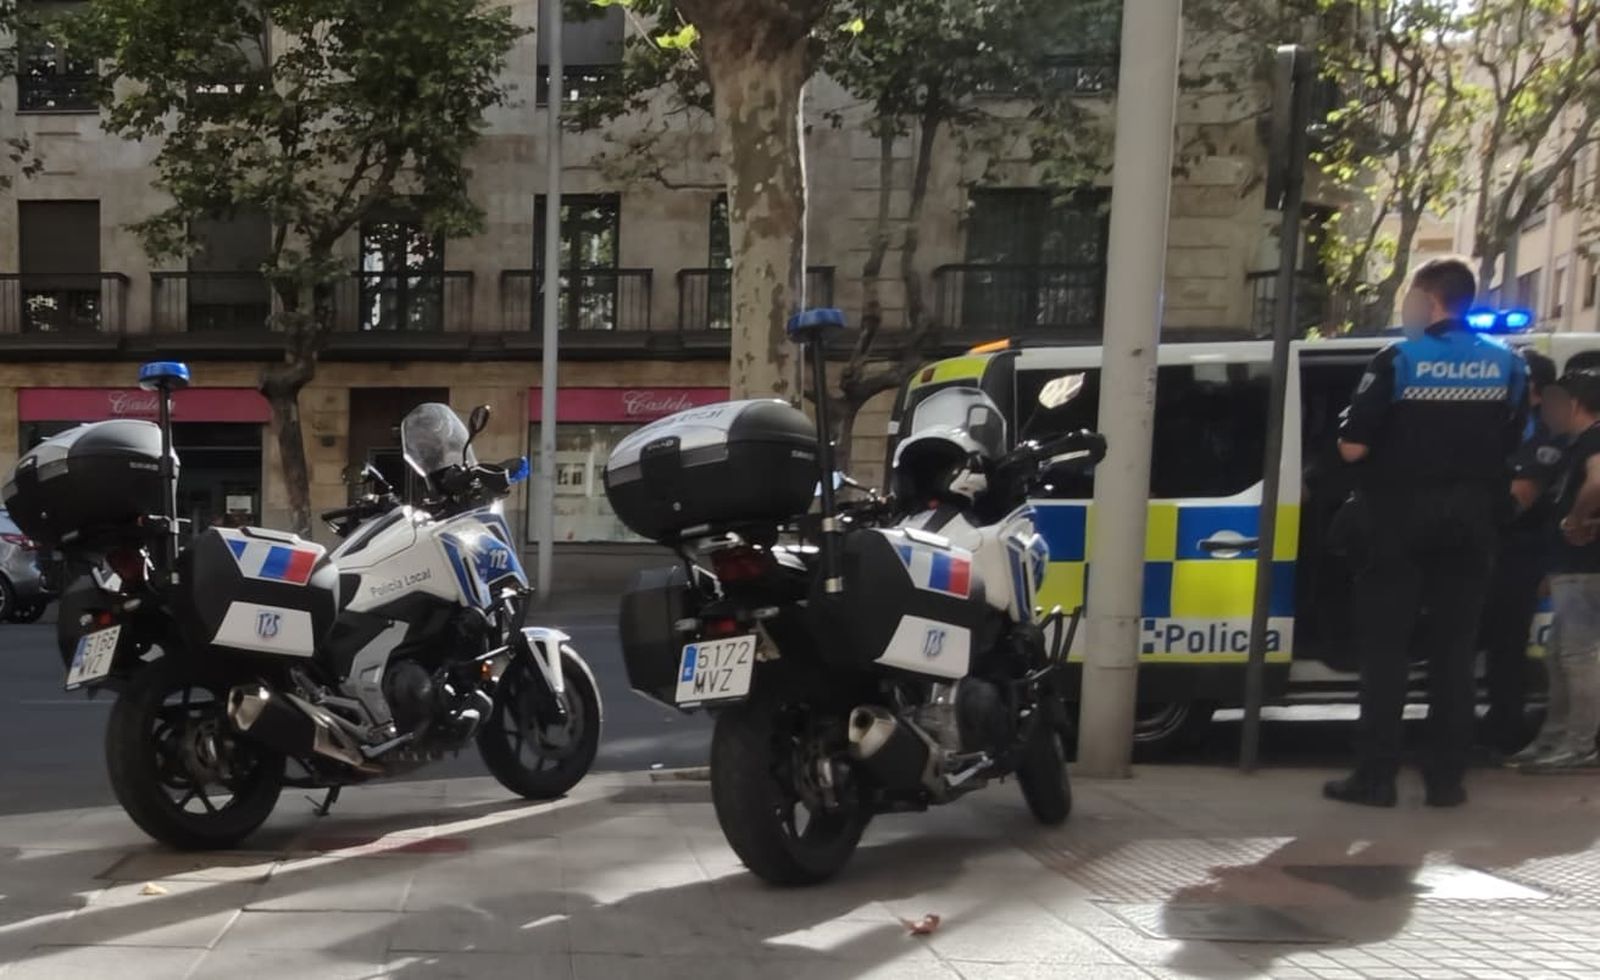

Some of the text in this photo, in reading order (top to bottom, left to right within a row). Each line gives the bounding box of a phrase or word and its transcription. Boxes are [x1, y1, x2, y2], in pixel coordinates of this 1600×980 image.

[404, 568, 431, 586] Local
[1165, 622, 1280, 653] Polica
[697, 641, 750, 669] 5172
[693, 668, 733, 695] MVZ
